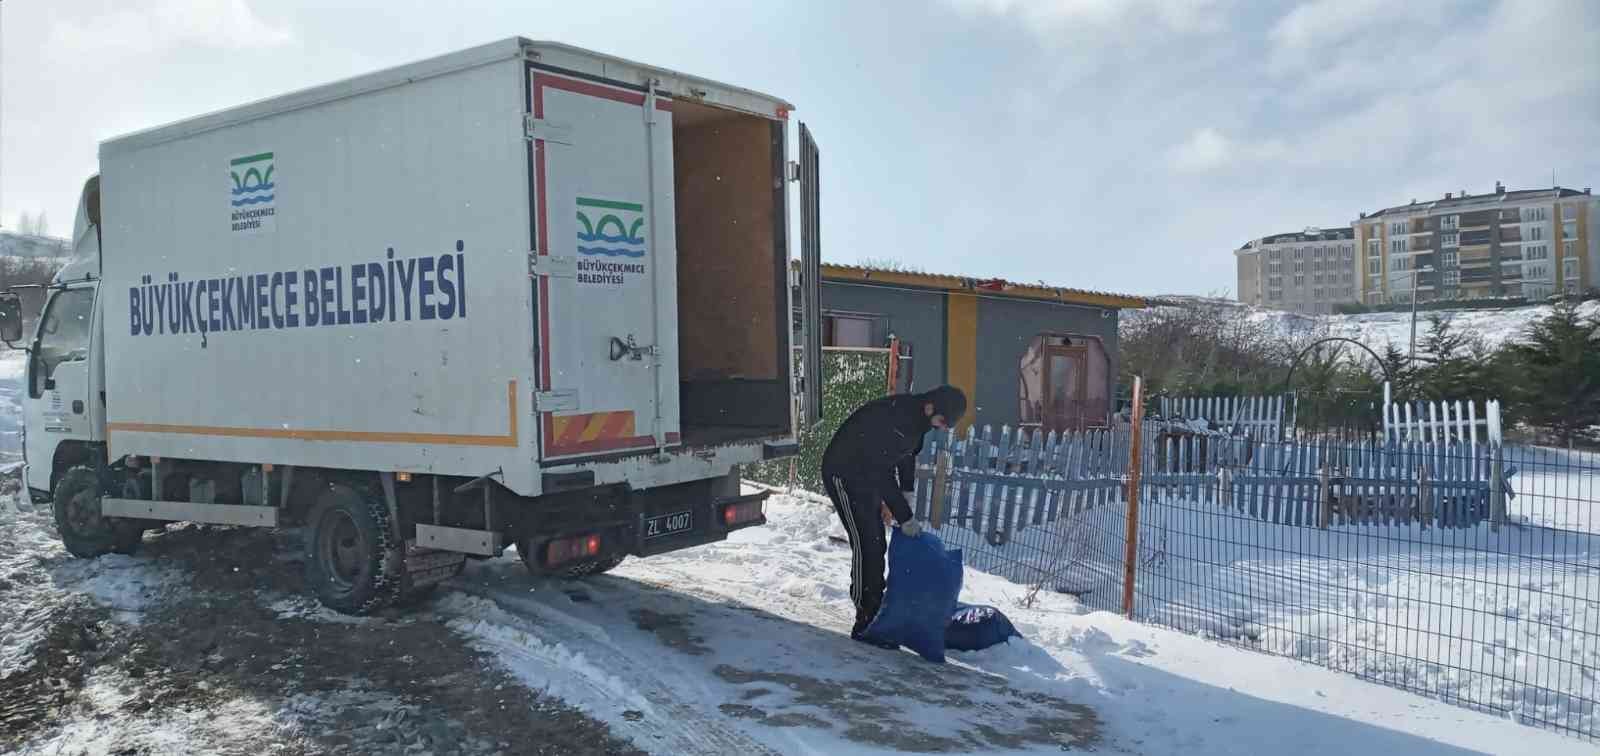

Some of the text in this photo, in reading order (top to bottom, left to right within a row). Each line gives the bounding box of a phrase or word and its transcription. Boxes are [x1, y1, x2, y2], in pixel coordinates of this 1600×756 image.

[577, 259, 645, 274] BÜYÜKÇEKMECE
[577, 272, 624, 284] BELEDİYESİ
[129, 240, 466, 349] BÜYÜKÇEKMECE BELEDİYESİ
[648, 513, 689, 536] ZL 4007
